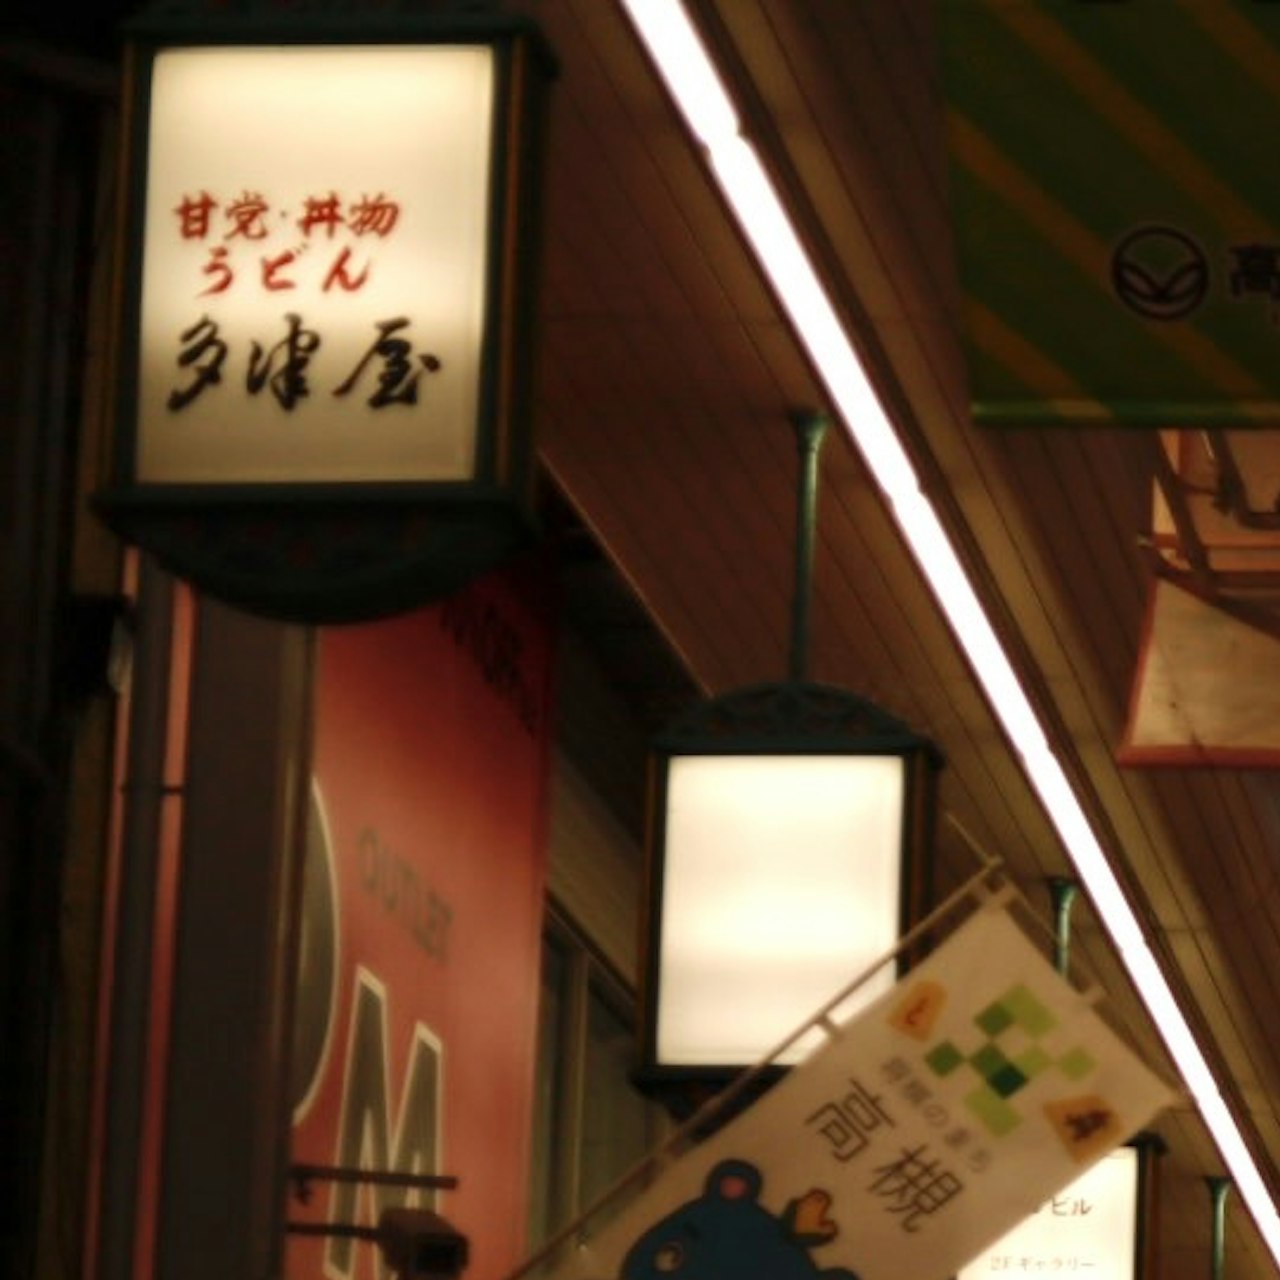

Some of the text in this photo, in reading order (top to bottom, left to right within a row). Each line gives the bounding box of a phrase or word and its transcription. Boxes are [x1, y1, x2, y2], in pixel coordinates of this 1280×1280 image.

[197, 243, 371, 299] うどん
[167, 313, 441, 413] 多津屋
[804, 1077, 966, 1233] 高槻
